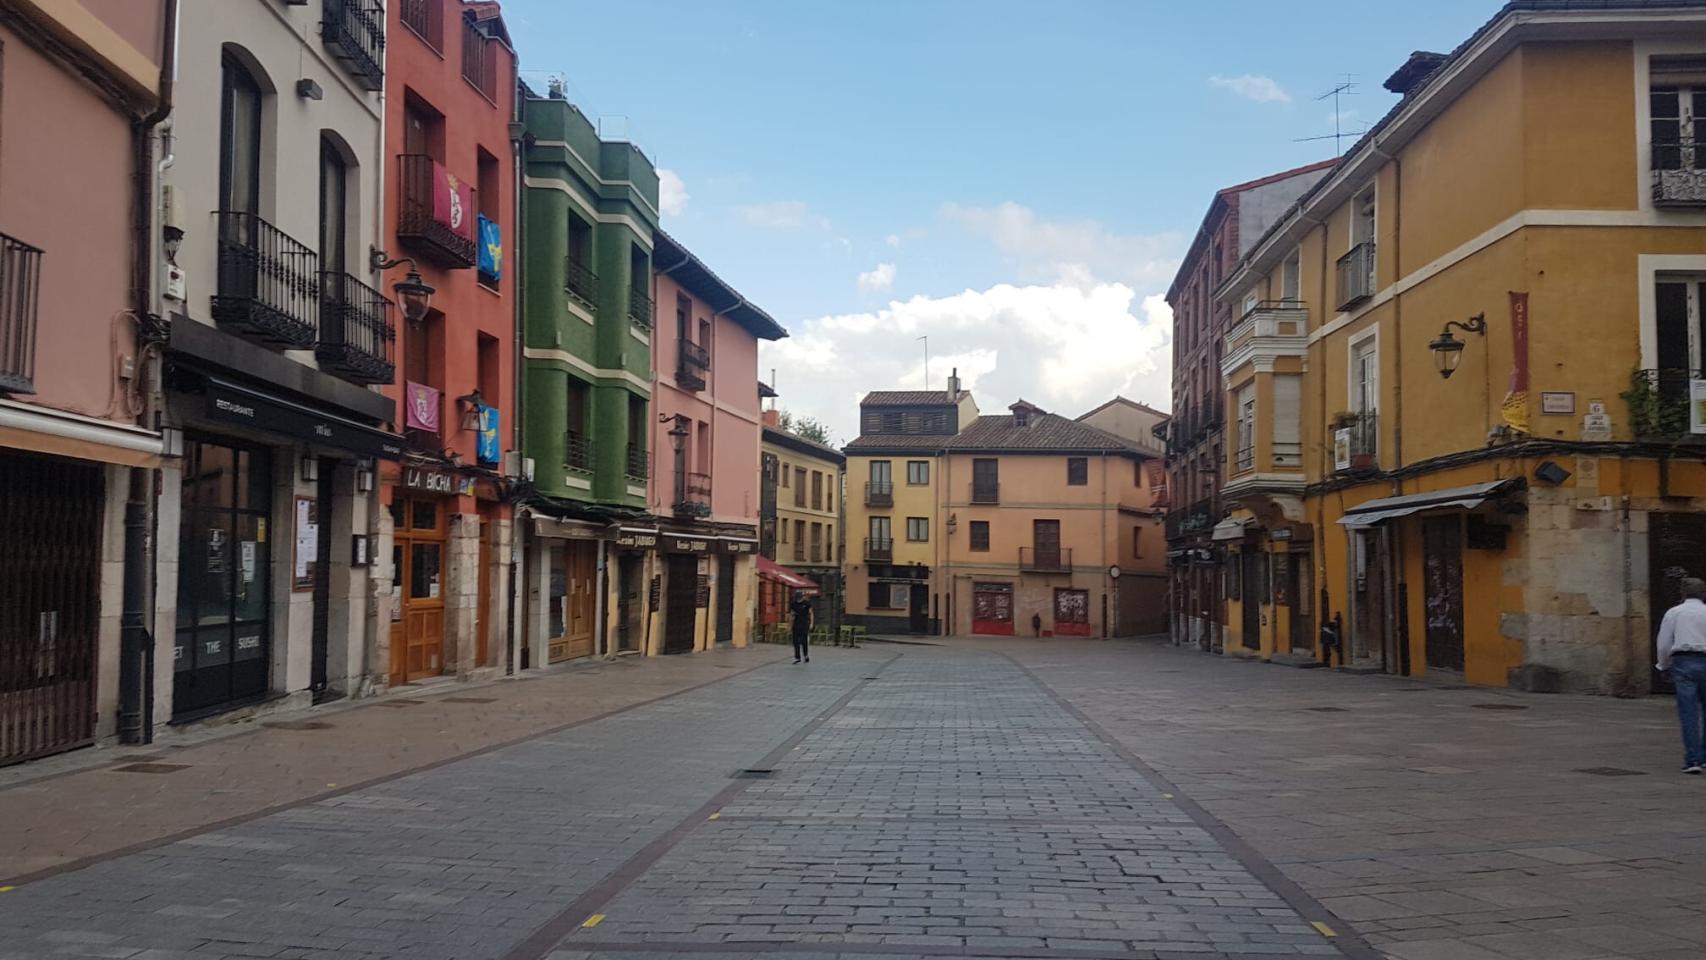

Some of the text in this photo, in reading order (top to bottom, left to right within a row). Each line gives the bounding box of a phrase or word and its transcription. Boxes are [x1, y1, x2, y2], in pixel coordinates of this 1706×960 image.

[216, 399, 254, 417] RESTAURANTE
[408, 469, 421, 488] LA
[426, 472, 451, 493] BICHA
[206, 640, 222, 654] THE
[238, 636, 260, 649] SUSHI
